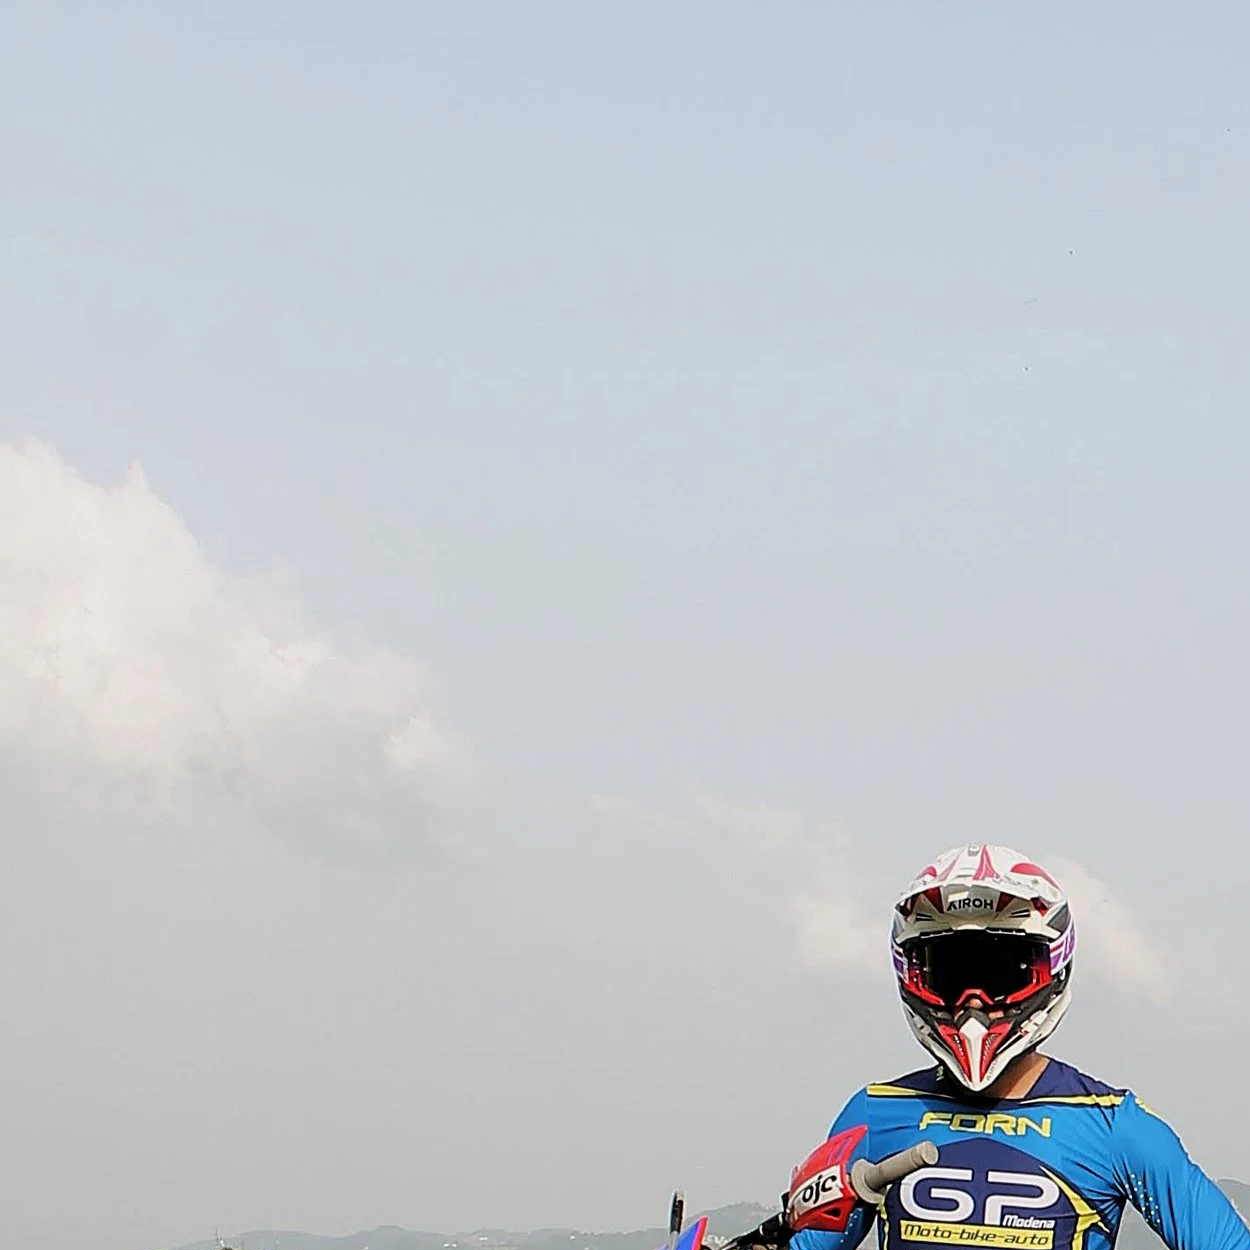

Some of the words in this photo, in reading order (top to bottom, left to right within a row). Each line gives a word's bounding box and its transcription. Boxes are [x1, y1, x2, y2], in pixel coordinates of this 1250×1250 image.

[946, 897, 994, 912] AIROH
[919, 1112, 1051, 1137] FORN
[900, 1167, 1060, 1225] GP
[1002, 1214, 1055, 1229] Modena
[903, 1224, 1050, 1246] Moto-bike-auto
